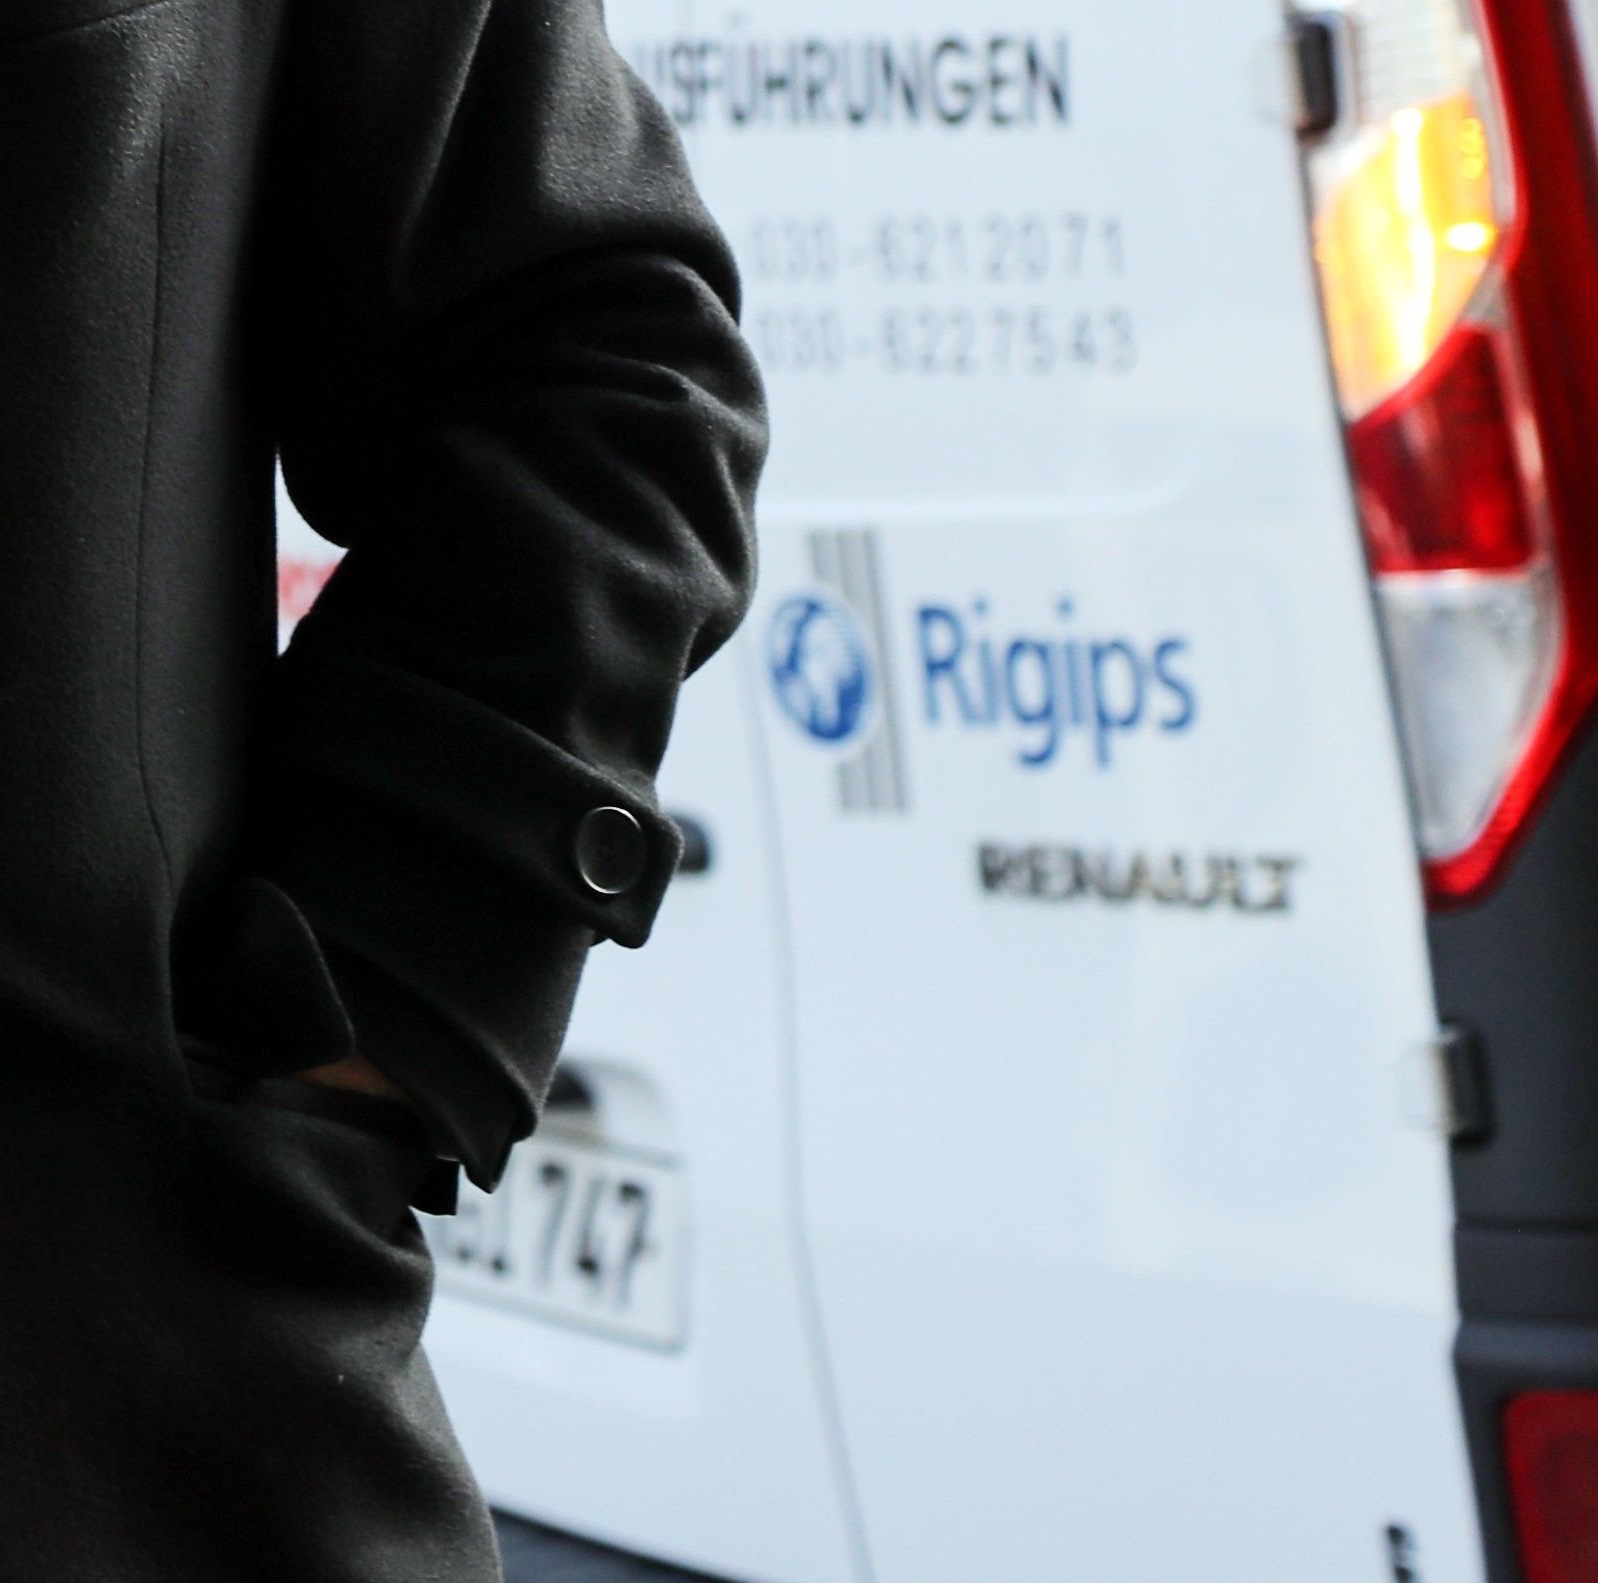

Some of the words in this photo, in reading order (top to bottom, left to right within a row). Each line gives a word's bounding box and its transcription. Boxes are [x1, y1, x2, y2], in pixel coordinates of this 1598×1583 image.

[915, 596, 1197, 769] Rigips
[978, 840, 1299, 914] RENAULT
[538, 1161, 657, 1312] 747
